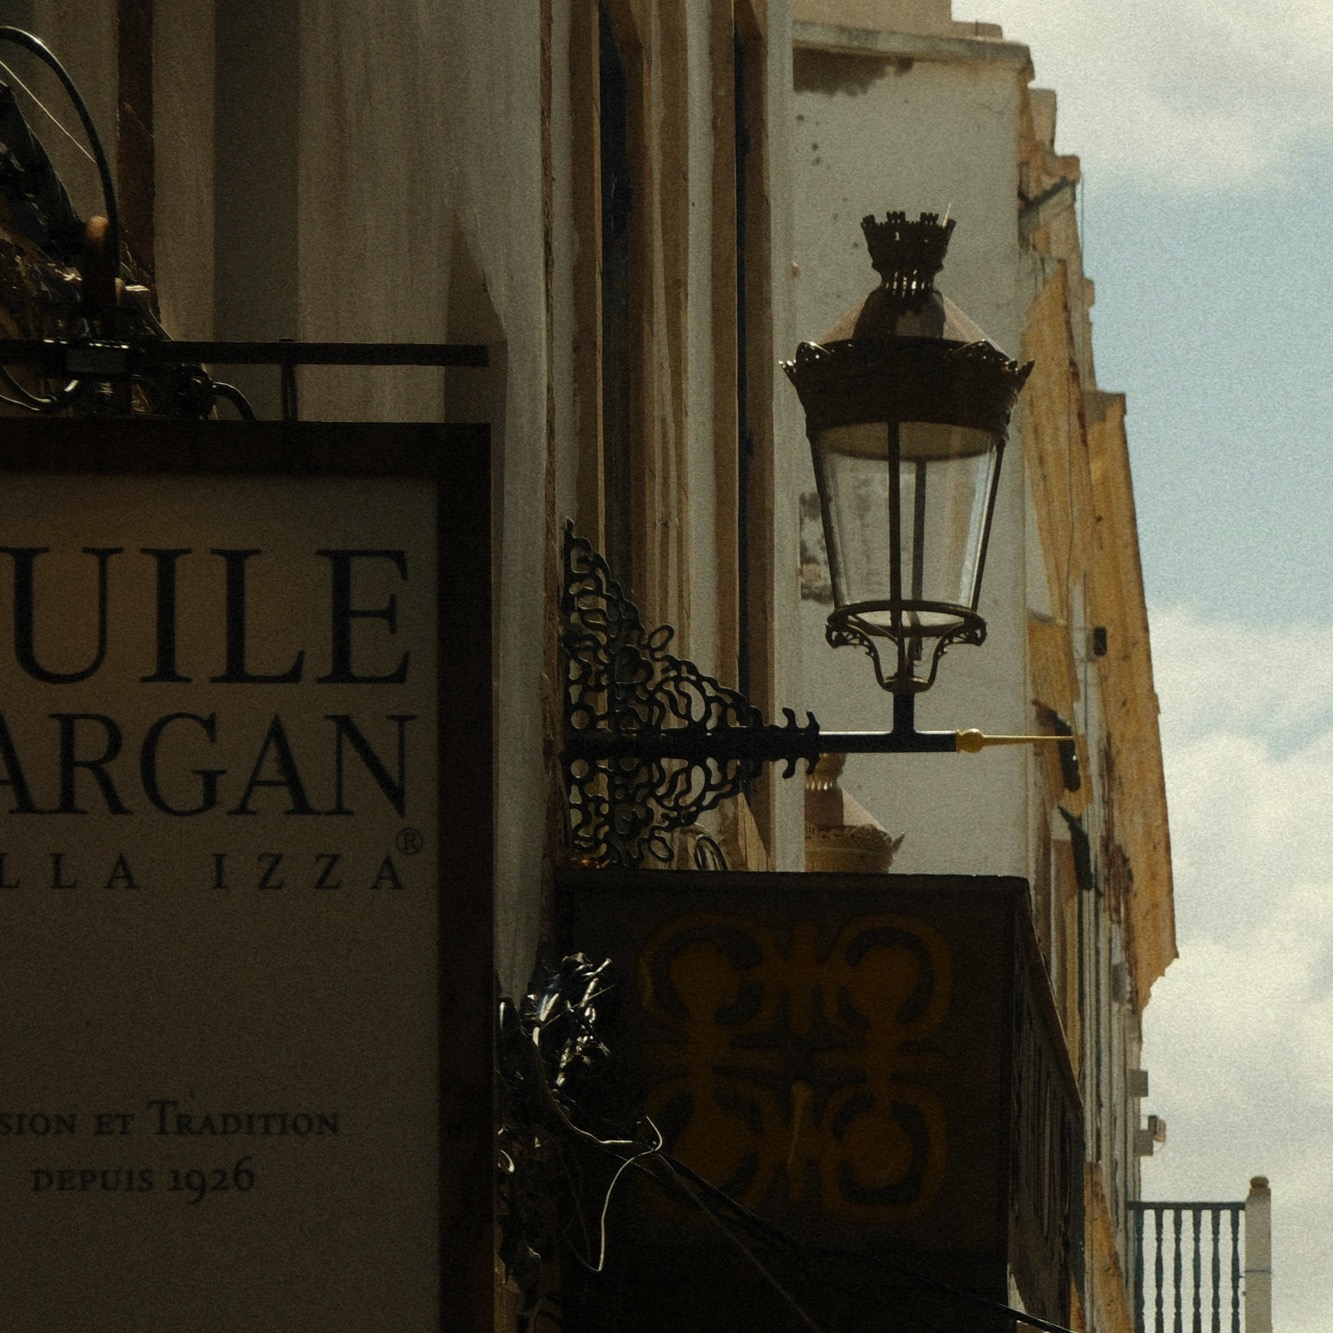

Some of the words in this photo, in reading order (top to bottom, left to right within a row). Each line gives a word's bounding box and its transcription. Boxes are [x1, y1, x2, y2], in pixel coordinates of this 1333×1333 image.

[0, 547, 410, 684] UILE
[212, 852, 405, 890] IZZA
[96, 1112, 134, 1136] ET
[31, 1169, 153, 1192] DEPUIS
[168, 1156, 256, 1205] 1926
